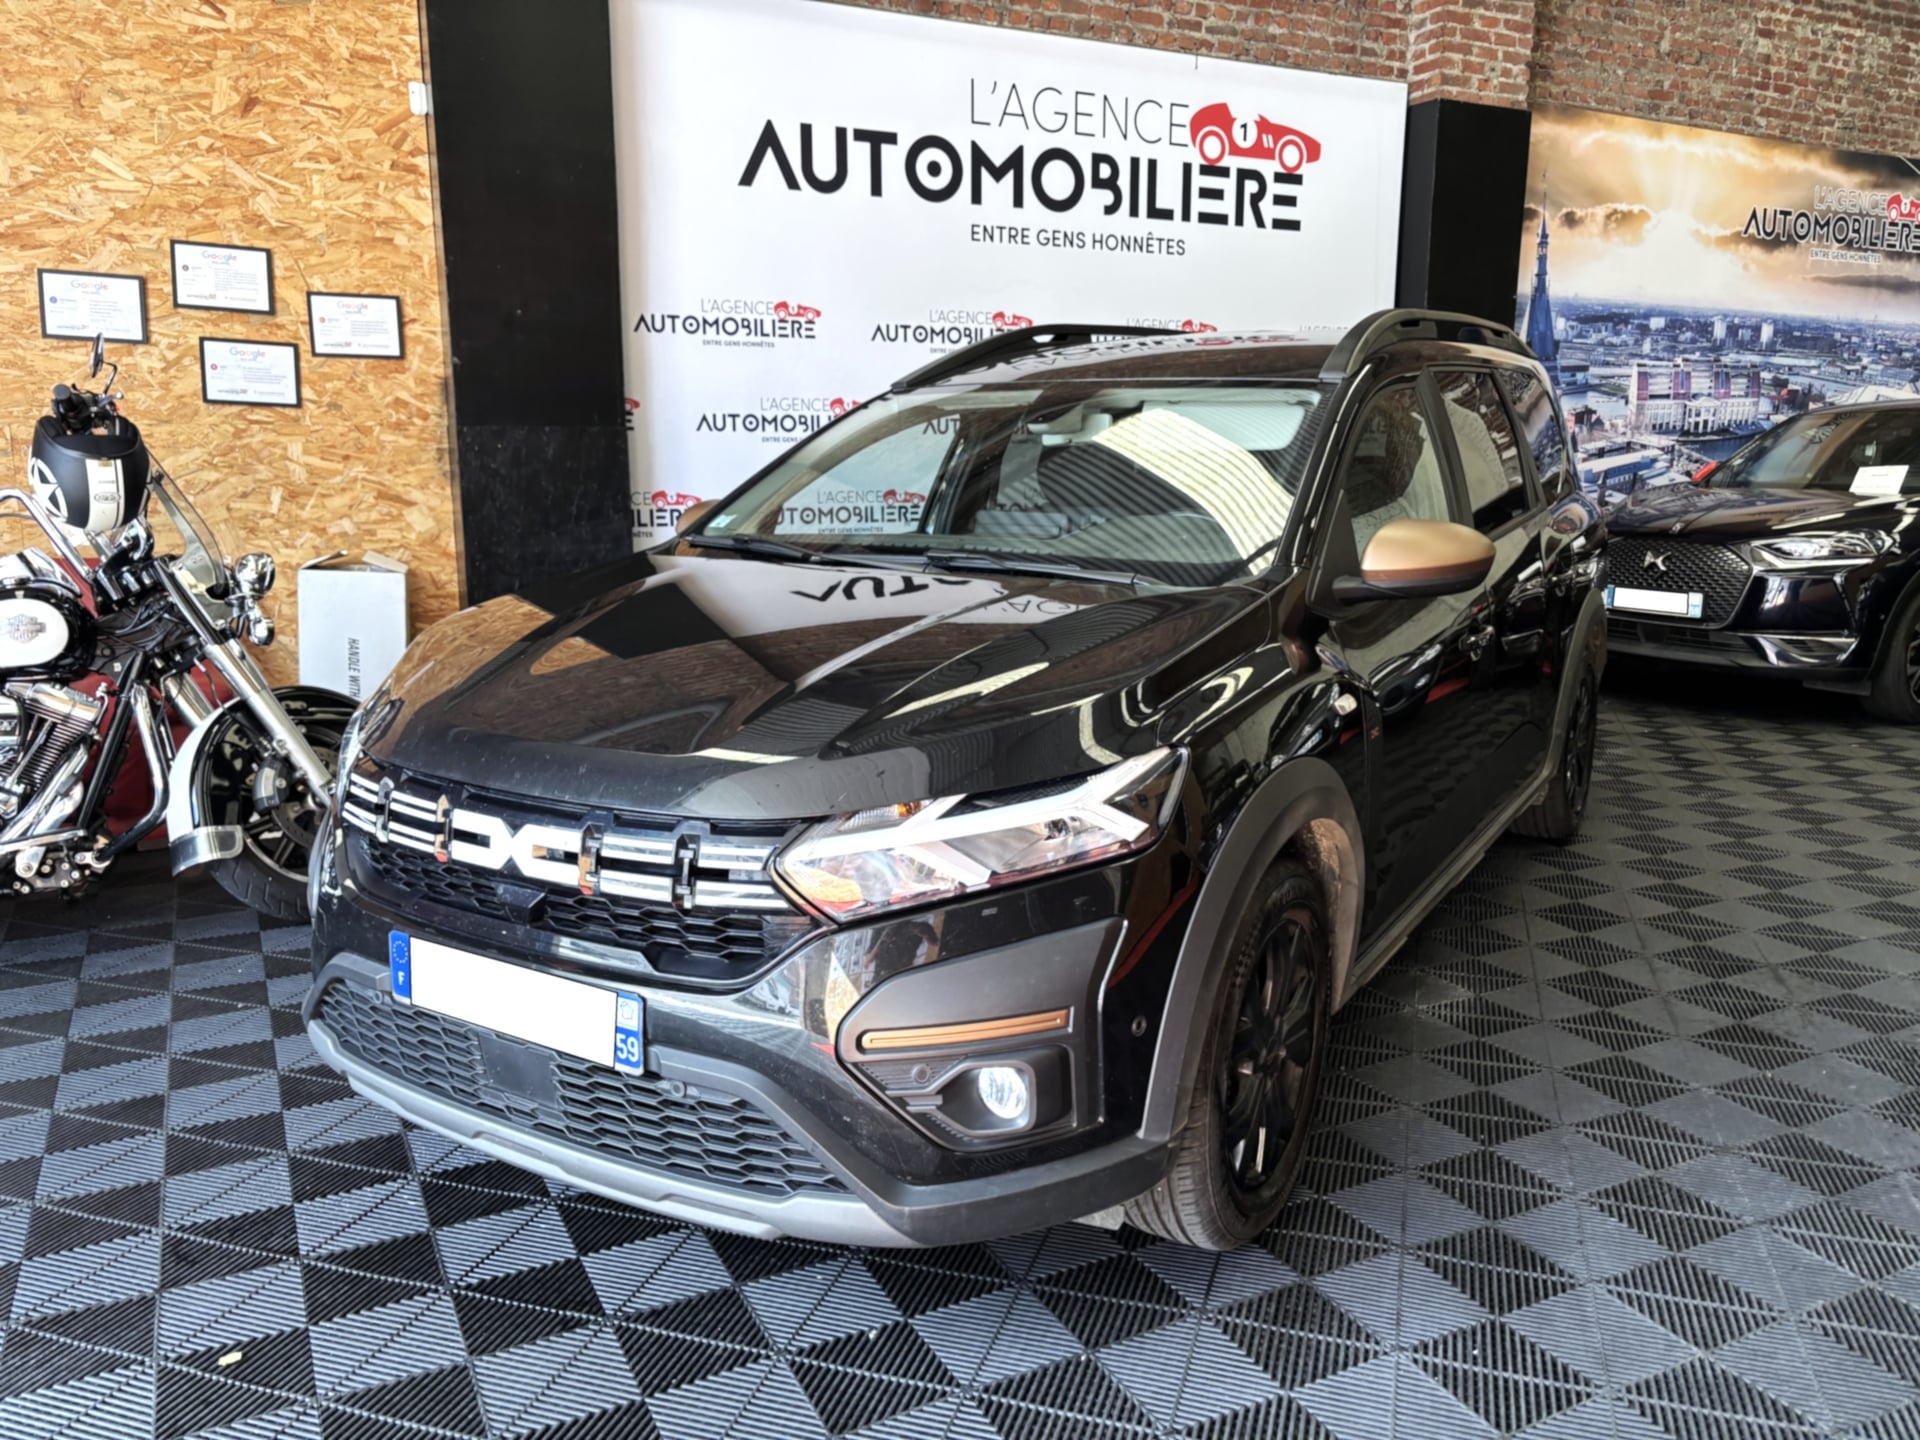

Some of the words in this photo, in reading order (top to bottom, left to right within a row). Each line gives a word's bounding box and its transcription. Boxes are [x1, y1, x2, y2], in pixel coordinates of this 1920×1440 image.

[970, 77, 1190, 148] L'AGENCE
[1814, 185, 1887, 216] L'AGENCE
[970, 223, 1031, 246] ENTRE
[1036, 228, 1086, 250] GENS
[1092, 231, 1187, 257] HONNÊTES
[202, 249, 238, 262] Google
[1810, 249, 1830, 260] ENTRE
[1831, 251, 1848, 261] GENS
[71, 279, 109, 293] Google
[700, 298, 774, 316] L'AGENCE
[929, 309, 993, 325] L'AGENCE
[702, 339, 723, 347] ENTRE
[724, 340, 741, 348] GENS
[229, 346, 266, 358] Google
[760, 397, 829, 412] L'AGENCE
[817, 489, 884, 504] L'AGENCE
[348, 637, 361, 673] HANDLE
[397, 970, 406, 986] F
[616, 1032, 640, 1063] 59
